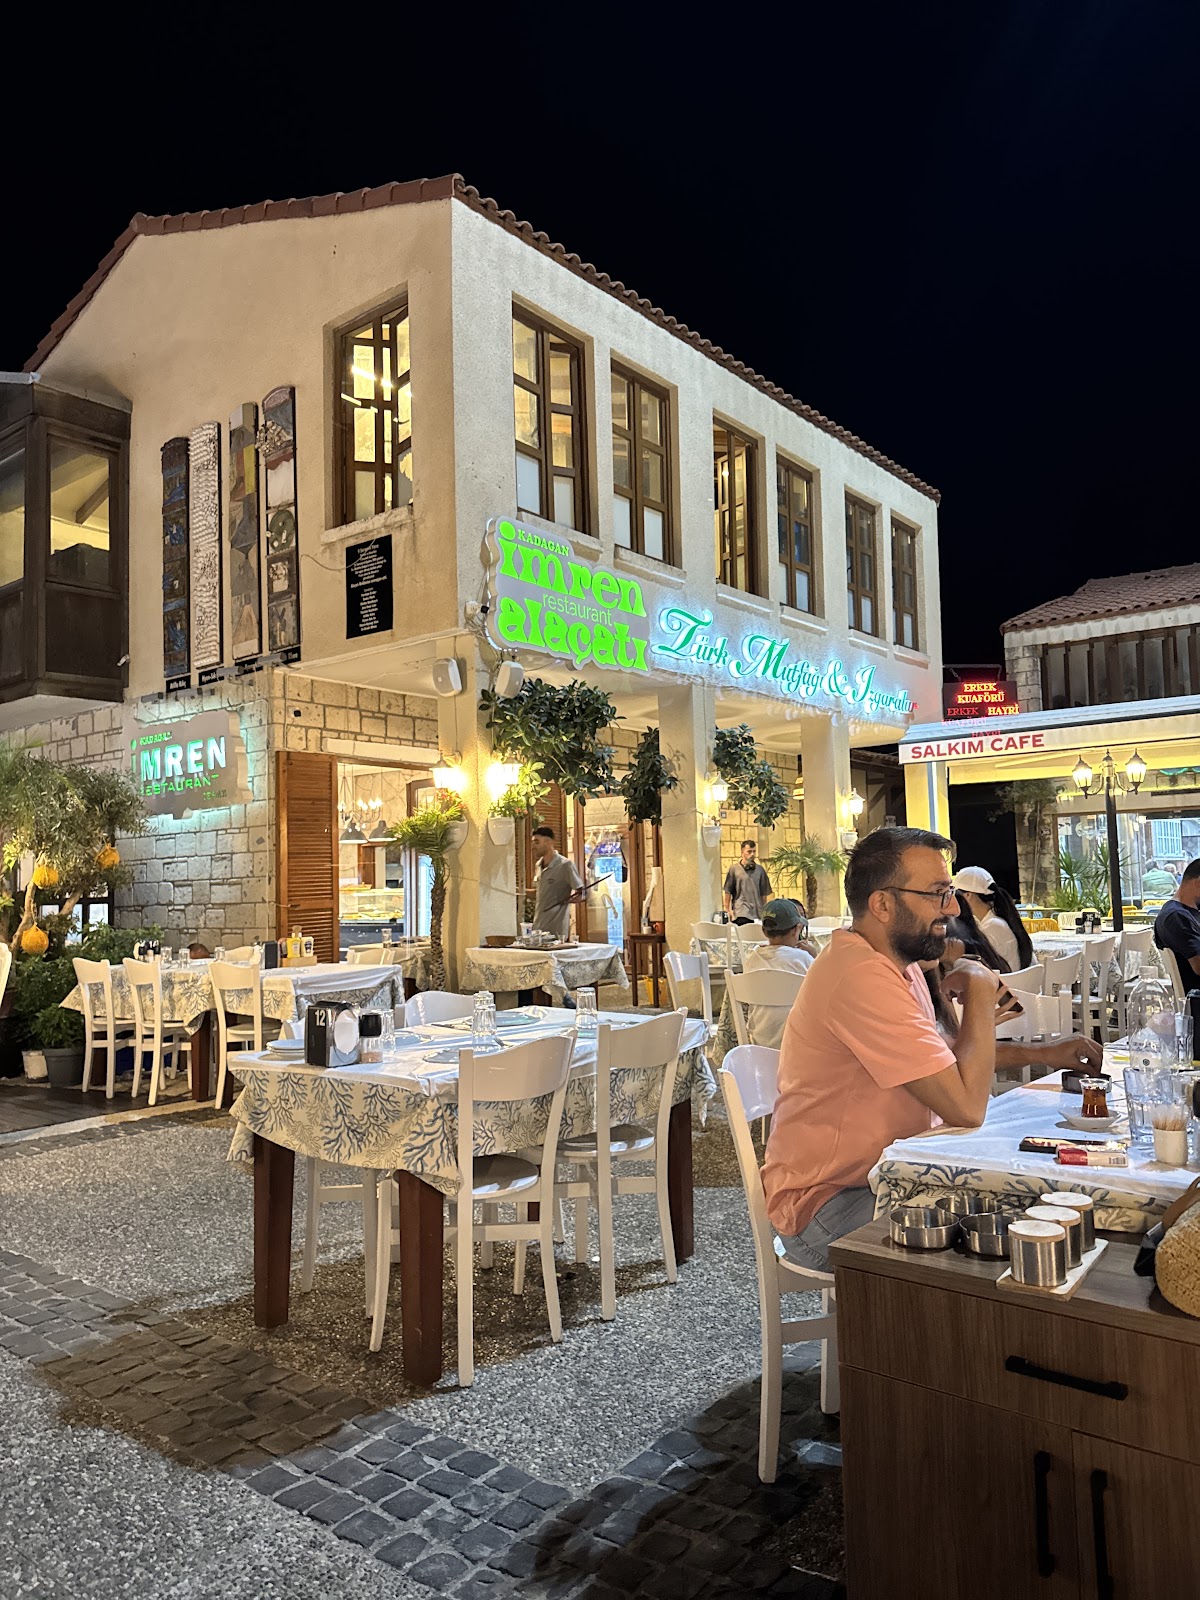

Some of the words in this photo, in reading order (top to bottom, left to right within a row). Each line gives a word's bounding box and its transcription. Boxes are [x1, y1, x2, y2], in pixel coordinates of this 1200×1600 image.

[518, 529, 570, 557] KADAGAN
[498, 521, 647, 617] imren
[542, 593, 613, 627] restaurant
[498, 597, 648, 671] alaçatı
[653, 608, 729, 667] Türk
[733, 634, 824, 697] Mutfağı
[825, 659, 848, 696] &
[957, 691, 1005, 704] KUAFÖRÜ
[963, 682, 997, 692] ERKEK
[987, 703, 1020, 716] HAYRİ
[911, 737, 984, 759] SALKIM
[990, 733, 1045, 752] CAFE
[314, 1009, 326, 1027] 12
